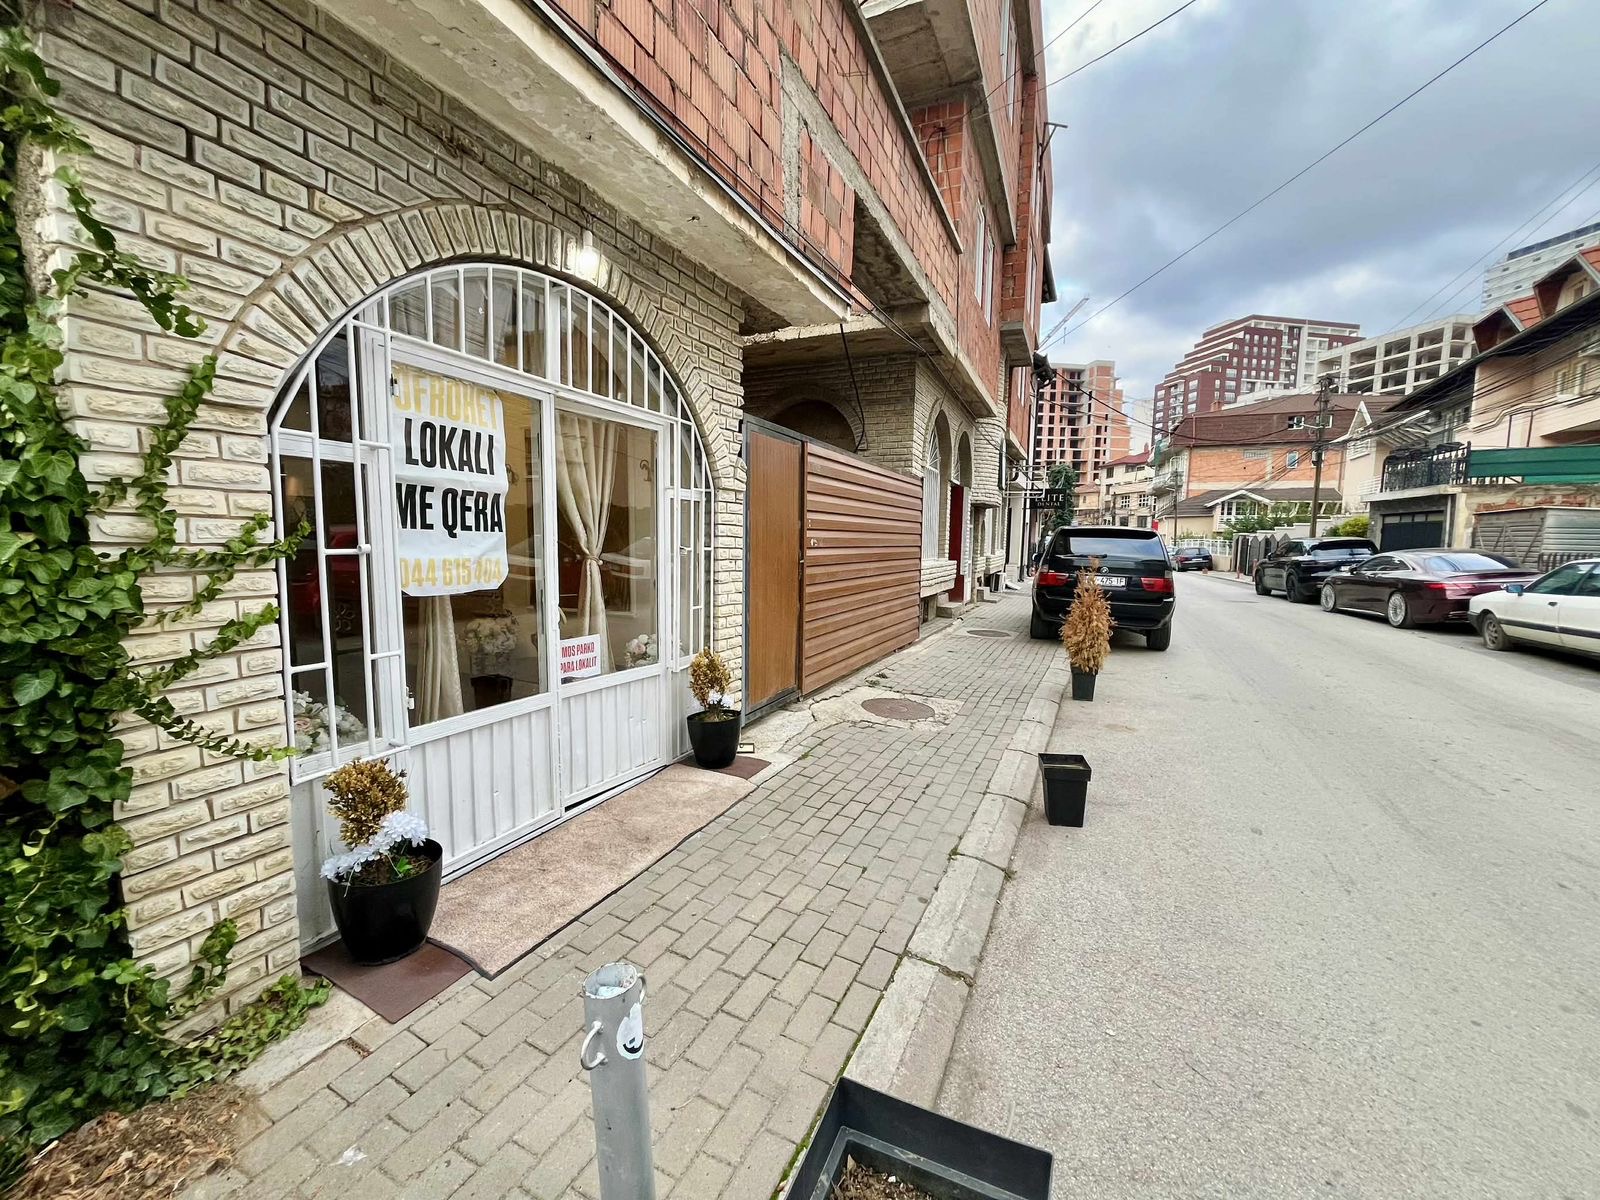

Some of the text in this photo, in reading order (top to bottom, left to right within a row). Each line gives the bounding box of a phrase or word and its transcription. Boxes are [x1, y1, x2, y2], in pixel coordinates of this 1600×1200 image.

[404, 417, 495, 476] LOKALI
[396, 482, 504, 539] ME QERA
[399, 557, 438, 589] 044
[442, 557, 472, 587] 615
[561, 641, 595, 658] MOS PARKO
[575, 656, 597, 671] LOKALIT
